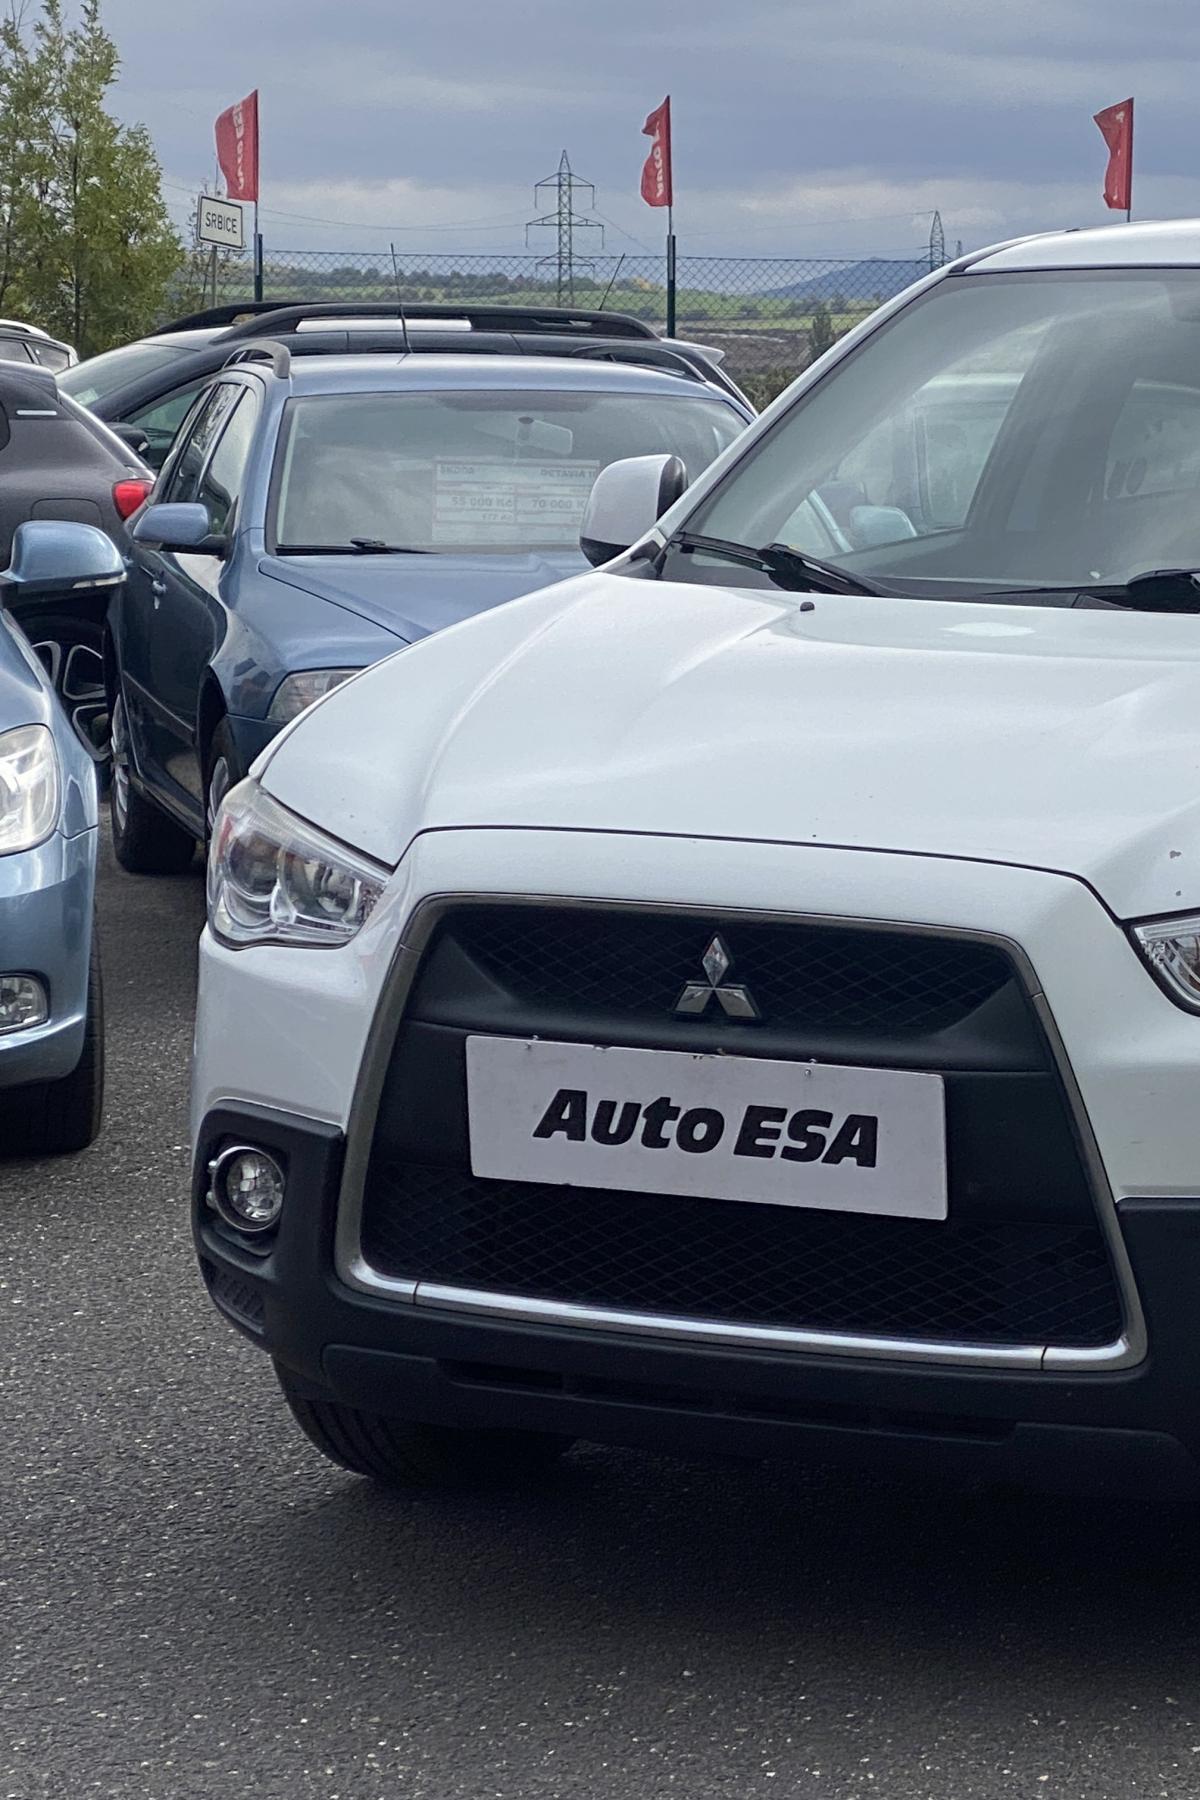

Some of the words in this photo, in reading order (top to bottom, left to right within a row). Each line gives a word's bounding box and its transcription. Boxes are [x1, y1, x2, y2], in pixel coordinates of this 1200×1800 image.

[205, 211, 238, 234] SRBICE
[533, 1088, 725, 1154] Auto
[732, 1104, 879, 1168] ESA
